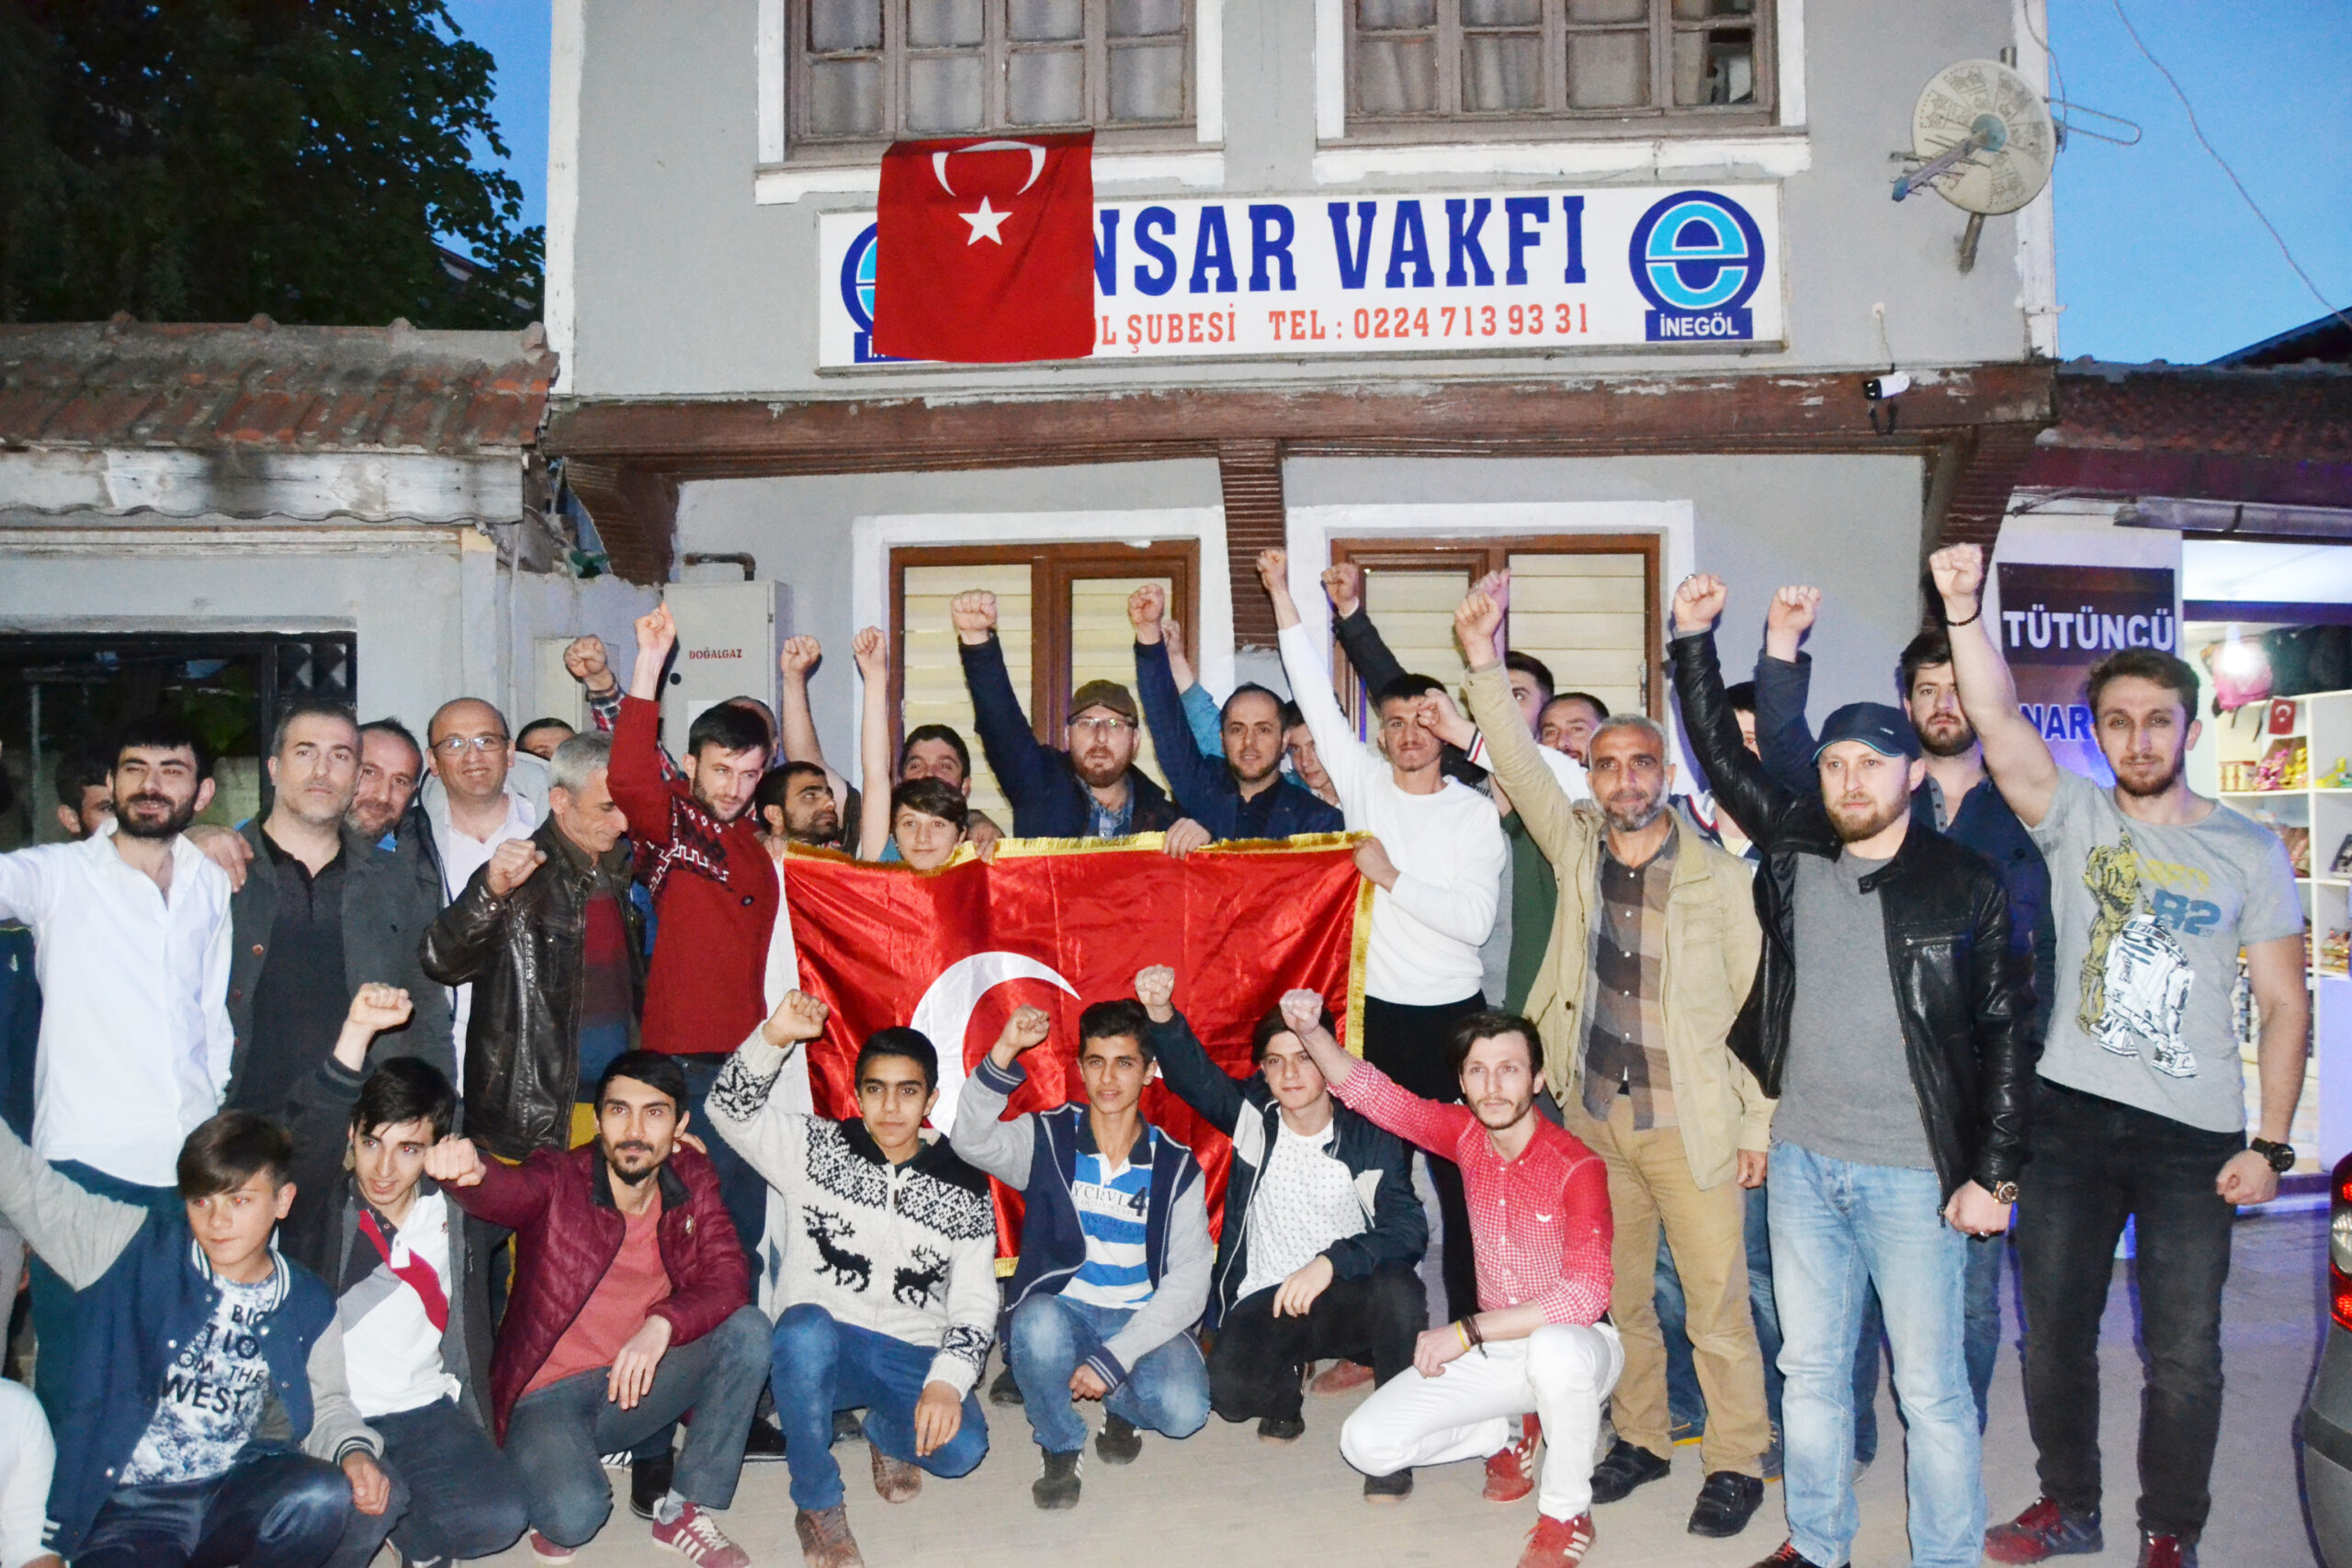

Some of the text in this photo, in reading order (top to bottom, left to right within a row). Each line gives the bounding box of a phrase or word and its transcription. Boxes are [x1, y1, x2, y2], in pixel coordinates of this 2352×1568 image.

[1328, 196, 1587, 288] VAKFI
[1127, 303, 1236, 353] ŞUBESİ
[1660, 312, 1740, 338] İNEGÖL
[2002, 604, 2174, 650] TÜTÜNCÜ
[689, 648, 742, 660] DOĞALGAZ
[2153, 888, 2222, 935] R2
[1127, 1186, 1148, 1217] 4
[162, 1373, 246, 1416] WEST
[229, 1364, 266, 1384] THE
